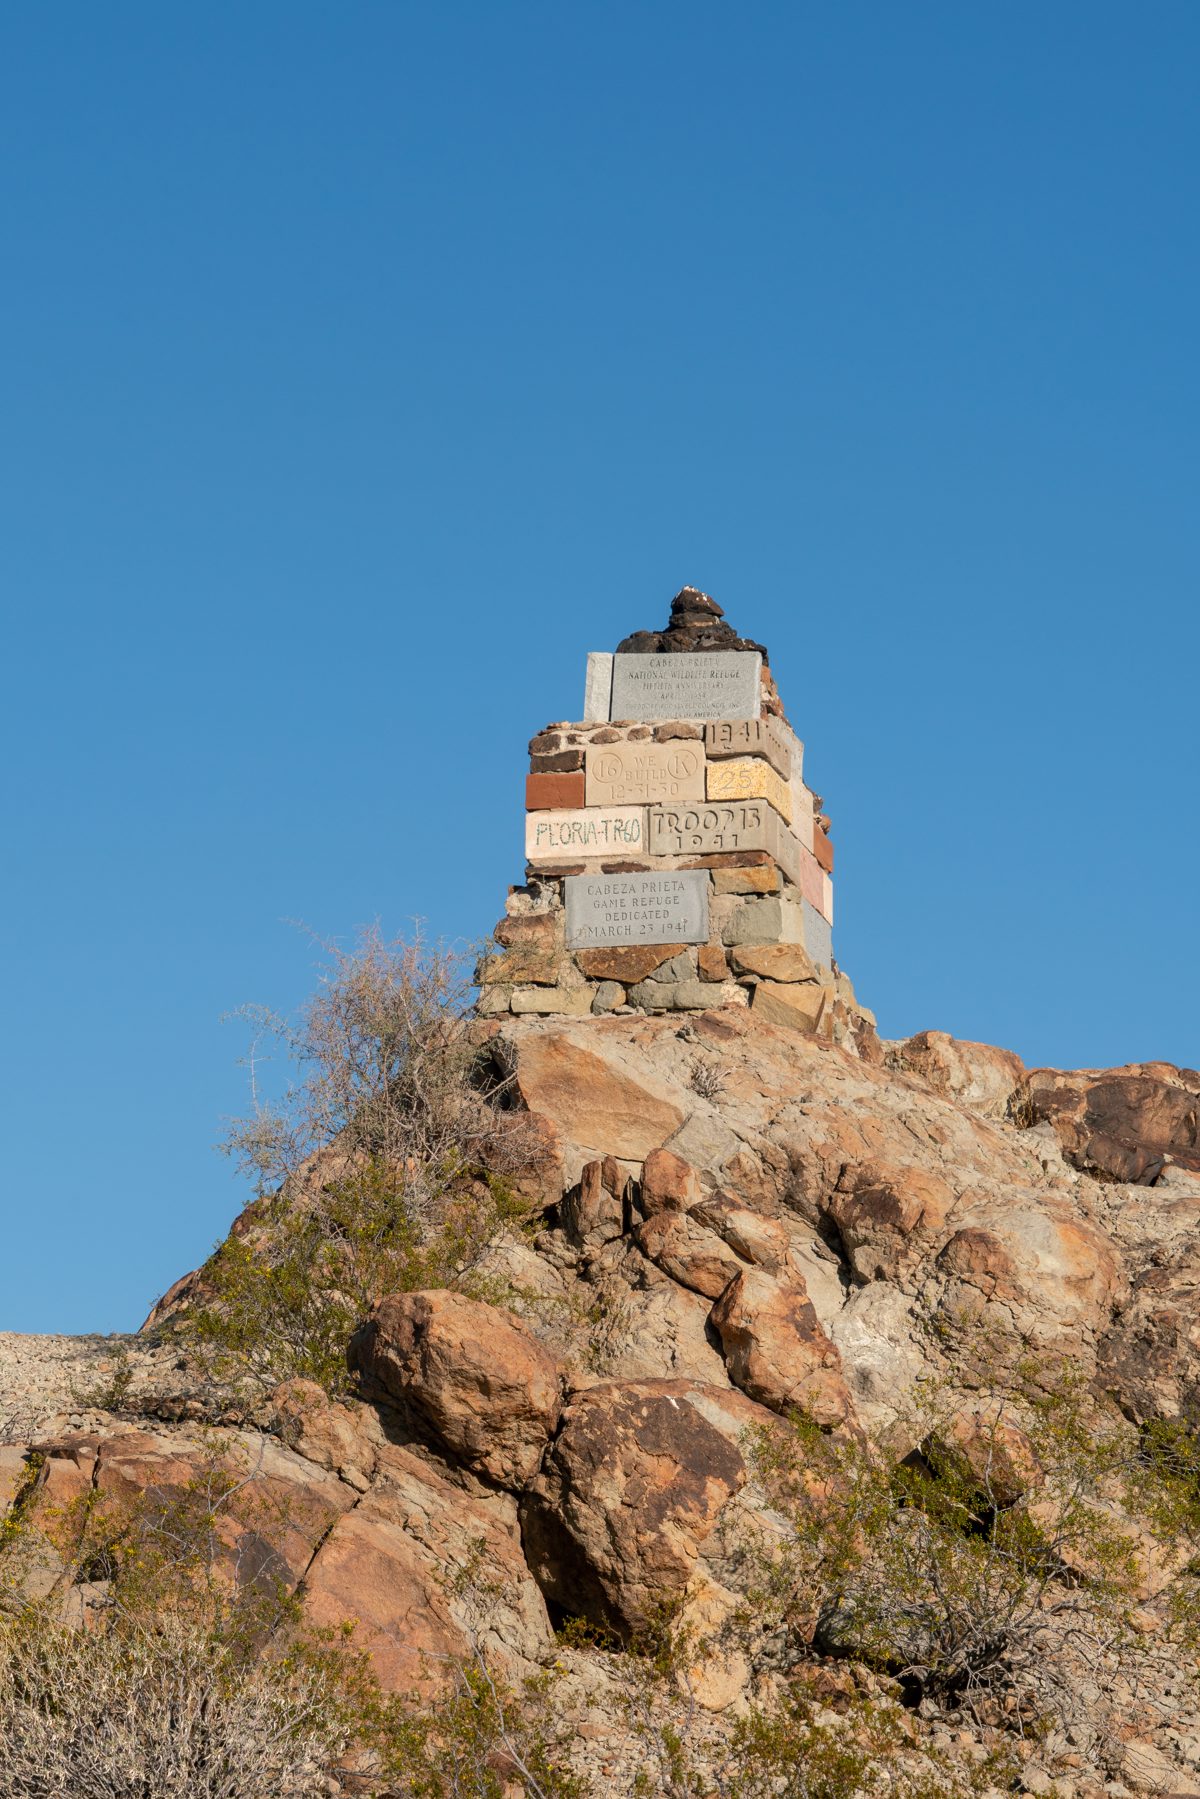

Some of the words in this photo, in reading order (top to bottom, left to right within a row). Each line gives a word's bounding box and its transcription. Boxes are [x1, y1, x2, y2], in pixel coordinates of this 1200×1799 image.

[709, 669, 740, 679] REFUGE
[633, 755, 657, 768] WE
[625, 769, 667, 781] BUILD
[720, 770, 752, 790] 25
[653, 809, 735, 834] TROOP
[676, 834, 738, 849] 1941
[587, 883, 637, 896] CABEZA
[642, 880, 685, 893] PRIETA
[593, 898, 627, 909] GAME
[632, 895, 680, 907] REFUGE
[605, 909, 670, 922] DEDICATED
[588, 924, 632, 938] MARCH
[662, 921, 687, 934] 1941
